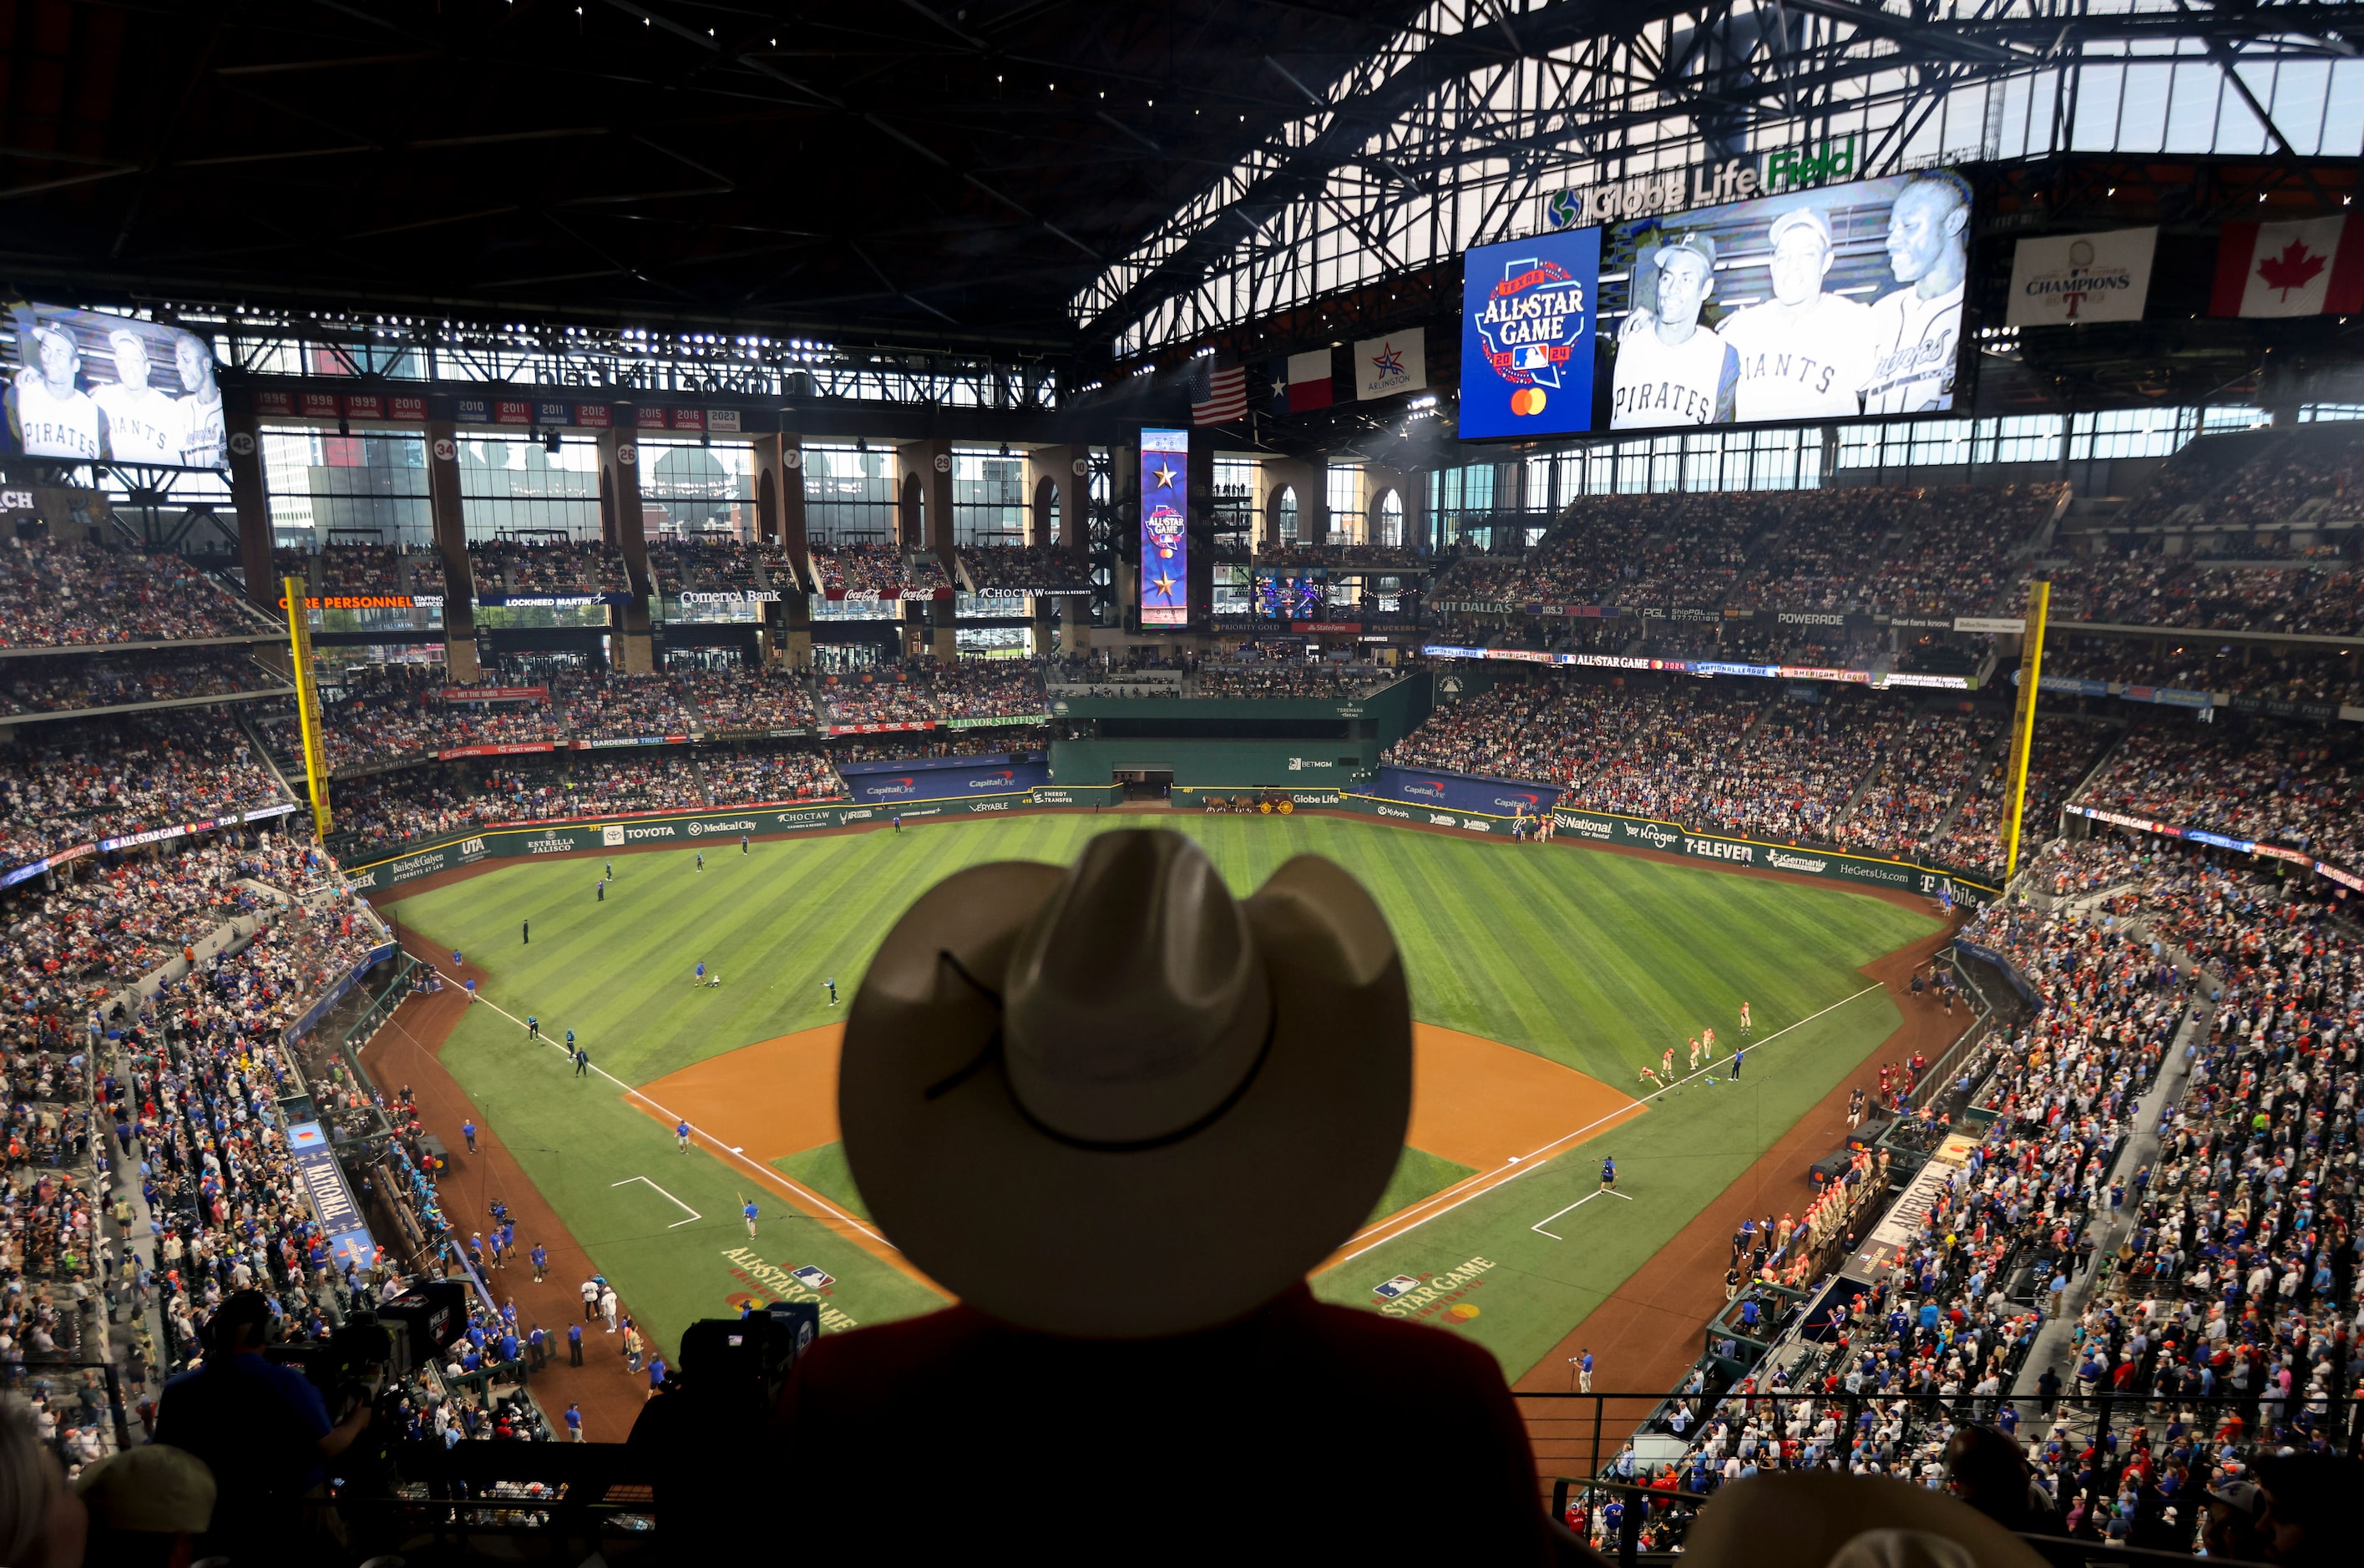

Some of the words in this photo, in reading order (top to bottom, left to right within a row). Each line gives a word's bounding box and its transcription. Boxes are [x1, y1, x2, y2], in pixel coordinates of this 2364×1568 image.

[1591, 178, 1686, 220] Globe
[1693, 159, 1757, 203] Life
[1767, 136, 1855, 189] Field
[1504, 271, 1541, 293] TEXAS
[2026, 273, 2131, 296] CHAMPIONS
[1500, 316, 1564, 346] GAME
[1552, 347, 1567, 359] 24
[1496, 354, 1510, 365] 20
[1368, 375, 1410, 392] ARLINGTON
[259, 393, 287, 404] 1996
[306, 395, 334, 406] 1998
[350, 397, 377, 407] 1999
[395, 398, 422, 409] 2010
[1614, 382, 1709, 426] PIRATES
[459, 401, 484, 412] 2010
[502, 403, 524, 413] 2011
[542, 404, 564, 415] 2011
[581, 406, 605, 417] 2012
[639, 408, 661, 418] 2015
[677, 410, 699, 420] 2016
[711, 411, 736, 421] 2023
[23, 422, 96, 459] PIRATES
[233, 437, 251, 451] 42
[436, 443, 454, 456] 34
[620, 448, 636, 461] 26
[788, 453, 797, 465] 7
[936, 458, 949, 469] 29
[1076, 462, 1085, 473] 10
[0, 491, 35, 509] CH
[1154, 525, 1178, 534] GAME
[747, 589, 782, 603] Bank
[844, 589, 882, 603] Coca-Cola
[899, 588, 936, 602] Coca-Cola
[985, 587, 1045, 599] CHOCTAW
[278, 597, 321, 609] CRE
[324, 595, 414, 609] PERSONNEL
[506, 598, 554, 607] LOCKHEED
[556, 596, 592, 605] MARTIN
[1440, 601, 1456, 612] UT
[1461, 602, 1512, 614] DALLAS
[1542, 606, 1563, 615] 105.3
[1643, 608, 1666, 618] PGL
[1778, 613, 1844, 625] POWERADE
[1891, 619, 1908, 627] Real
[1909, 619, 1926, 627] fans
[1620, 657, 1649, 670] GAME
[1664, 662, 1685, 670] 2024
[1793, 670, 1835, 680] AMERICAN
[958, 718, 993, 729] LUXOR
[992, 716, 1045, 727] STAFFING
[593, 738, 639, 747] GARDENERS
[640, 736, 664, 745] TRUST
[311, 721, 324, 777] HEAT
[385, 760, 402, 768] SHIFT
[1293, 794, 1320, 805] Globe
[1322, 794, 1339, 804] Life
[784, 812, 830, 822] CHOCTAW
[1388, 807, 1410, 818] Kubota
[219, 815, 238, 827] 7:10
[703, 822, 738, 833] Medical
[738, 820, 757, 833] City
[2129, 818, 2154, 832] GAME
[159, 826, 186, 842] GAME
[626, 826, 676, 839] TOYOTA
[1592, 832, 1610, 840] Rental
[1640, 823, 1678, 849] Kroger
[462, 837, 485, 855] UTA
[528, 838, 575, 848] ESTRELLA
[533, 844, 571, 854] JALISCO
[1781, 853, 1827, 869] Germania
[393, 870, 423, 882] ATTORNEYS
[1840, 864, 1909, 883] HeGetsUs.com
[1942, 878, 1977, 908] Mbile
[305, 1162, 352, 1222] NATIONAL
[1889, 1174, 1945, 1232] AMERICAN
[1431, 1256, 1497, 1290] GAME
[430, 1307, 449, 1328] MLB
